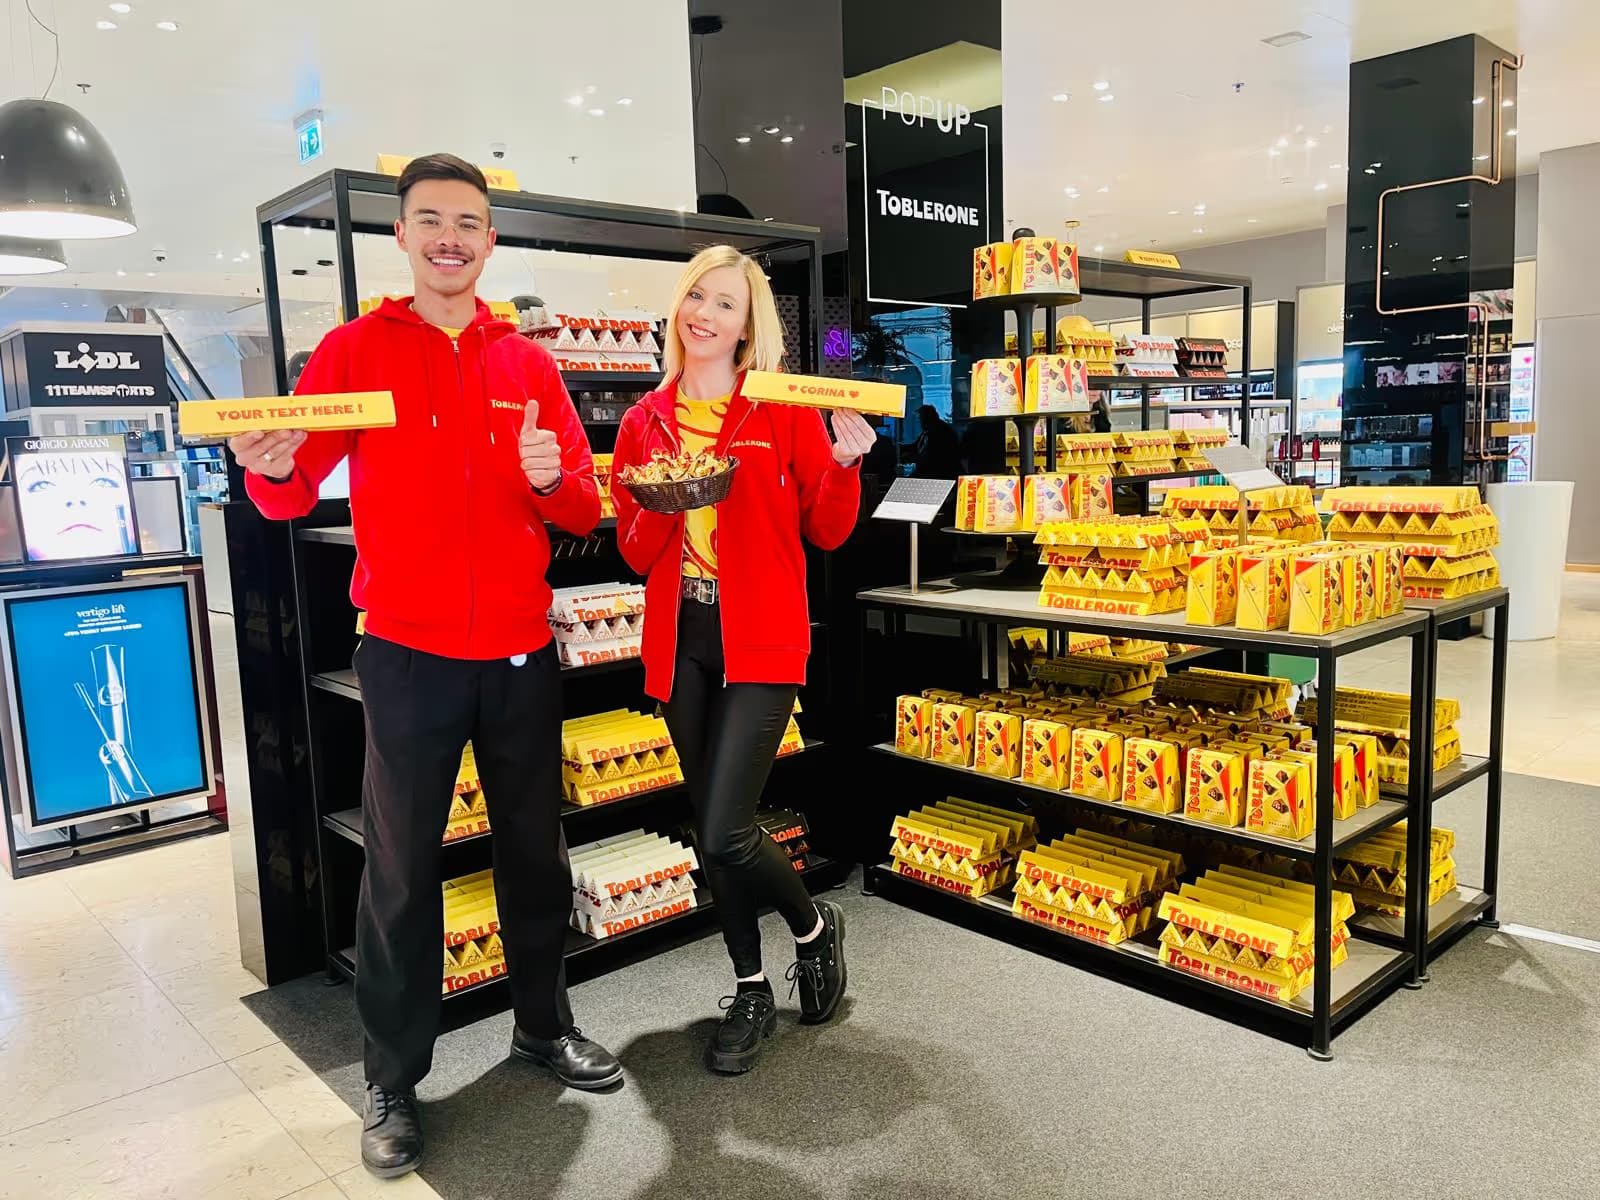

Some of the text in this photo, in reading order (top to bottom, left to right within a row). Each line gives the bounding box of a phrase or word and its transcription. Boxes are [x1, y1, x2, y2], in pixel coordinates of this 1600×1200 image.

[876, 189, 979, 226] TOBLERONE
[555, 314, 652, 331] TOBLERONE
[54, 342, 140, 373] LIDL
[800, 385, 846, 398] CORINA
[216, 403, 363, 421] YOUR TEXT HERE !
[24, 438, 109, 450] GIORGIO ARMANI
[1171, 497, 1263, 511] TOBLEROE
[1329, 498, 1445, 513] TOBLERONE
[76, 603, 126, 618] vertigo lift
[1047, 594, 1140, 615] TOBLERONE
[587, 773, 677, 803] TOBLERONE
[897, 826, 973, 858] TOBLERONE
[604, 861, 692, 897] TOBLERONE
[898, 862, 973, 896] TOBLERONE
[1024, 861, 1116, 900] TOBLERONE
[601, 898, 690, 937] TOBLERONE
[1021, 900, 1111, 942] TOBLERONE
[1168, 905, 1279, 955] TOBLERONE
[1168, 947, 1281, 997] TOBLERONE
